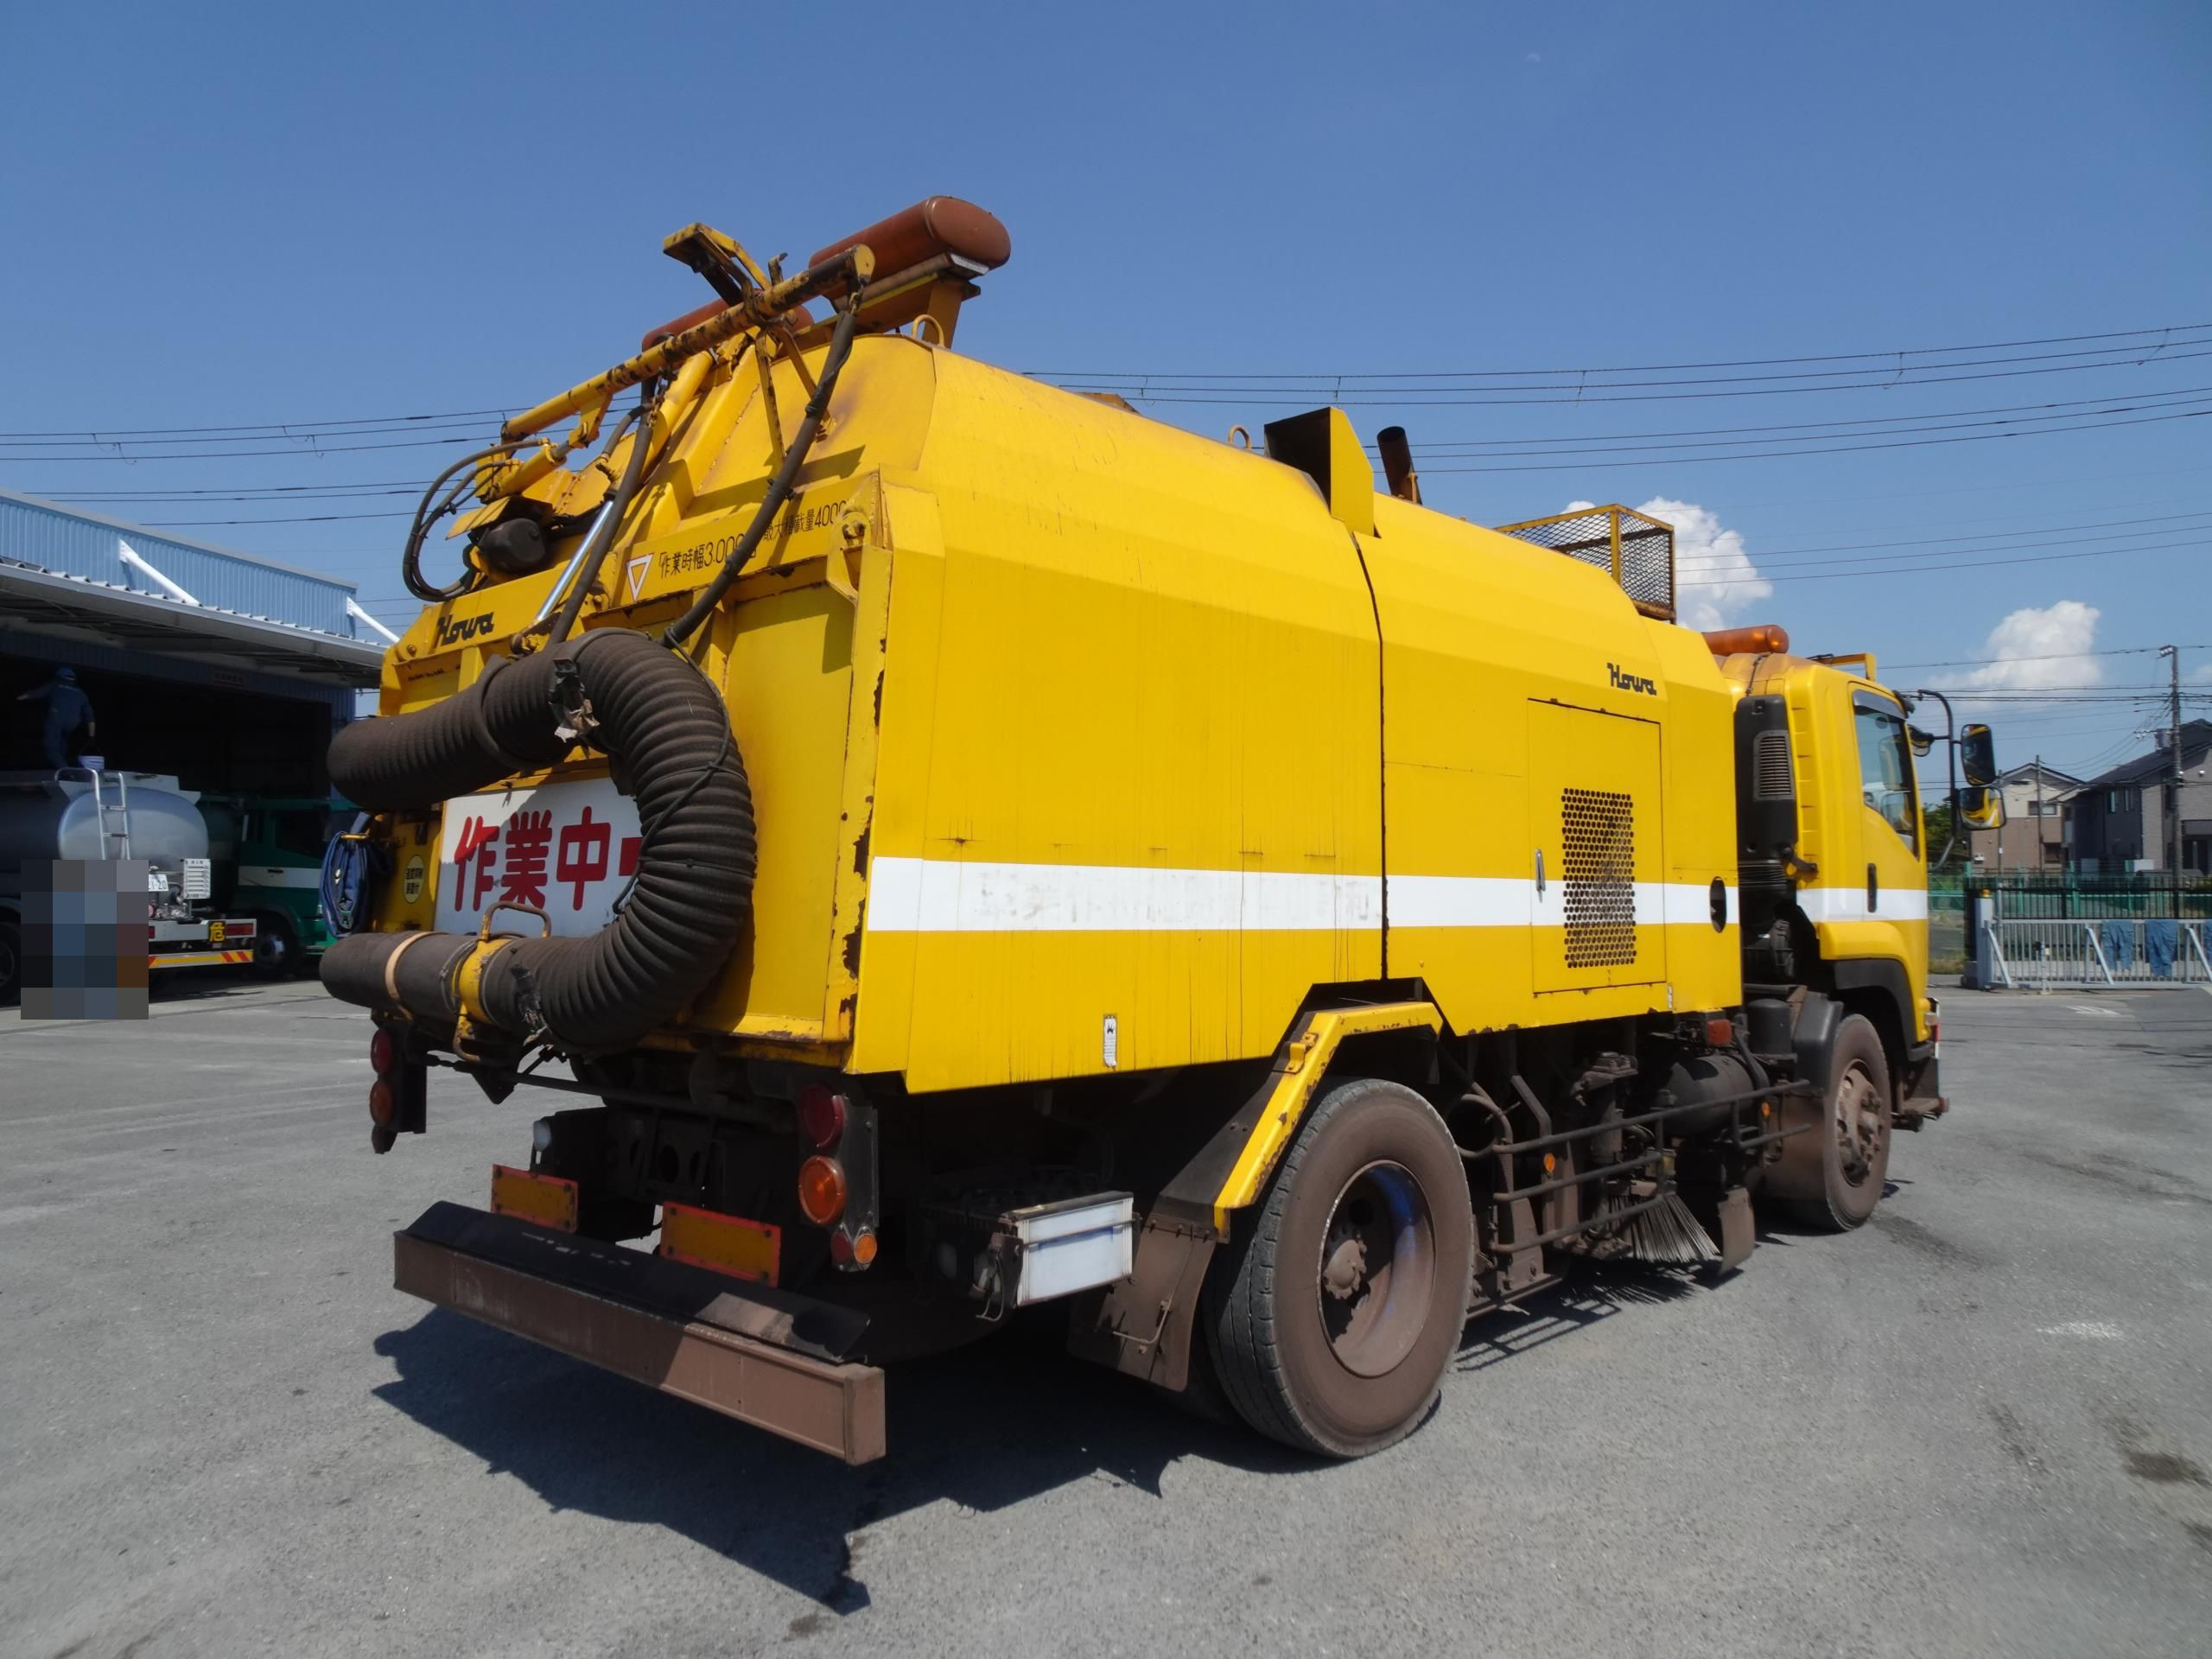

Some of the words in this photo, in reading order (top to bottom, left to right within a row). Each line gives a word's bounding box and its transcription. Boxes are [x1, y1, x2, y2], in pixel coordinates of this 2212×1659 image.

[436, 611, 495, 648] Howa
[1606, 662, 1657, 696] Howa
[454, 806, 611, 912] 作業中
[209, 921, 226, 942] 危
